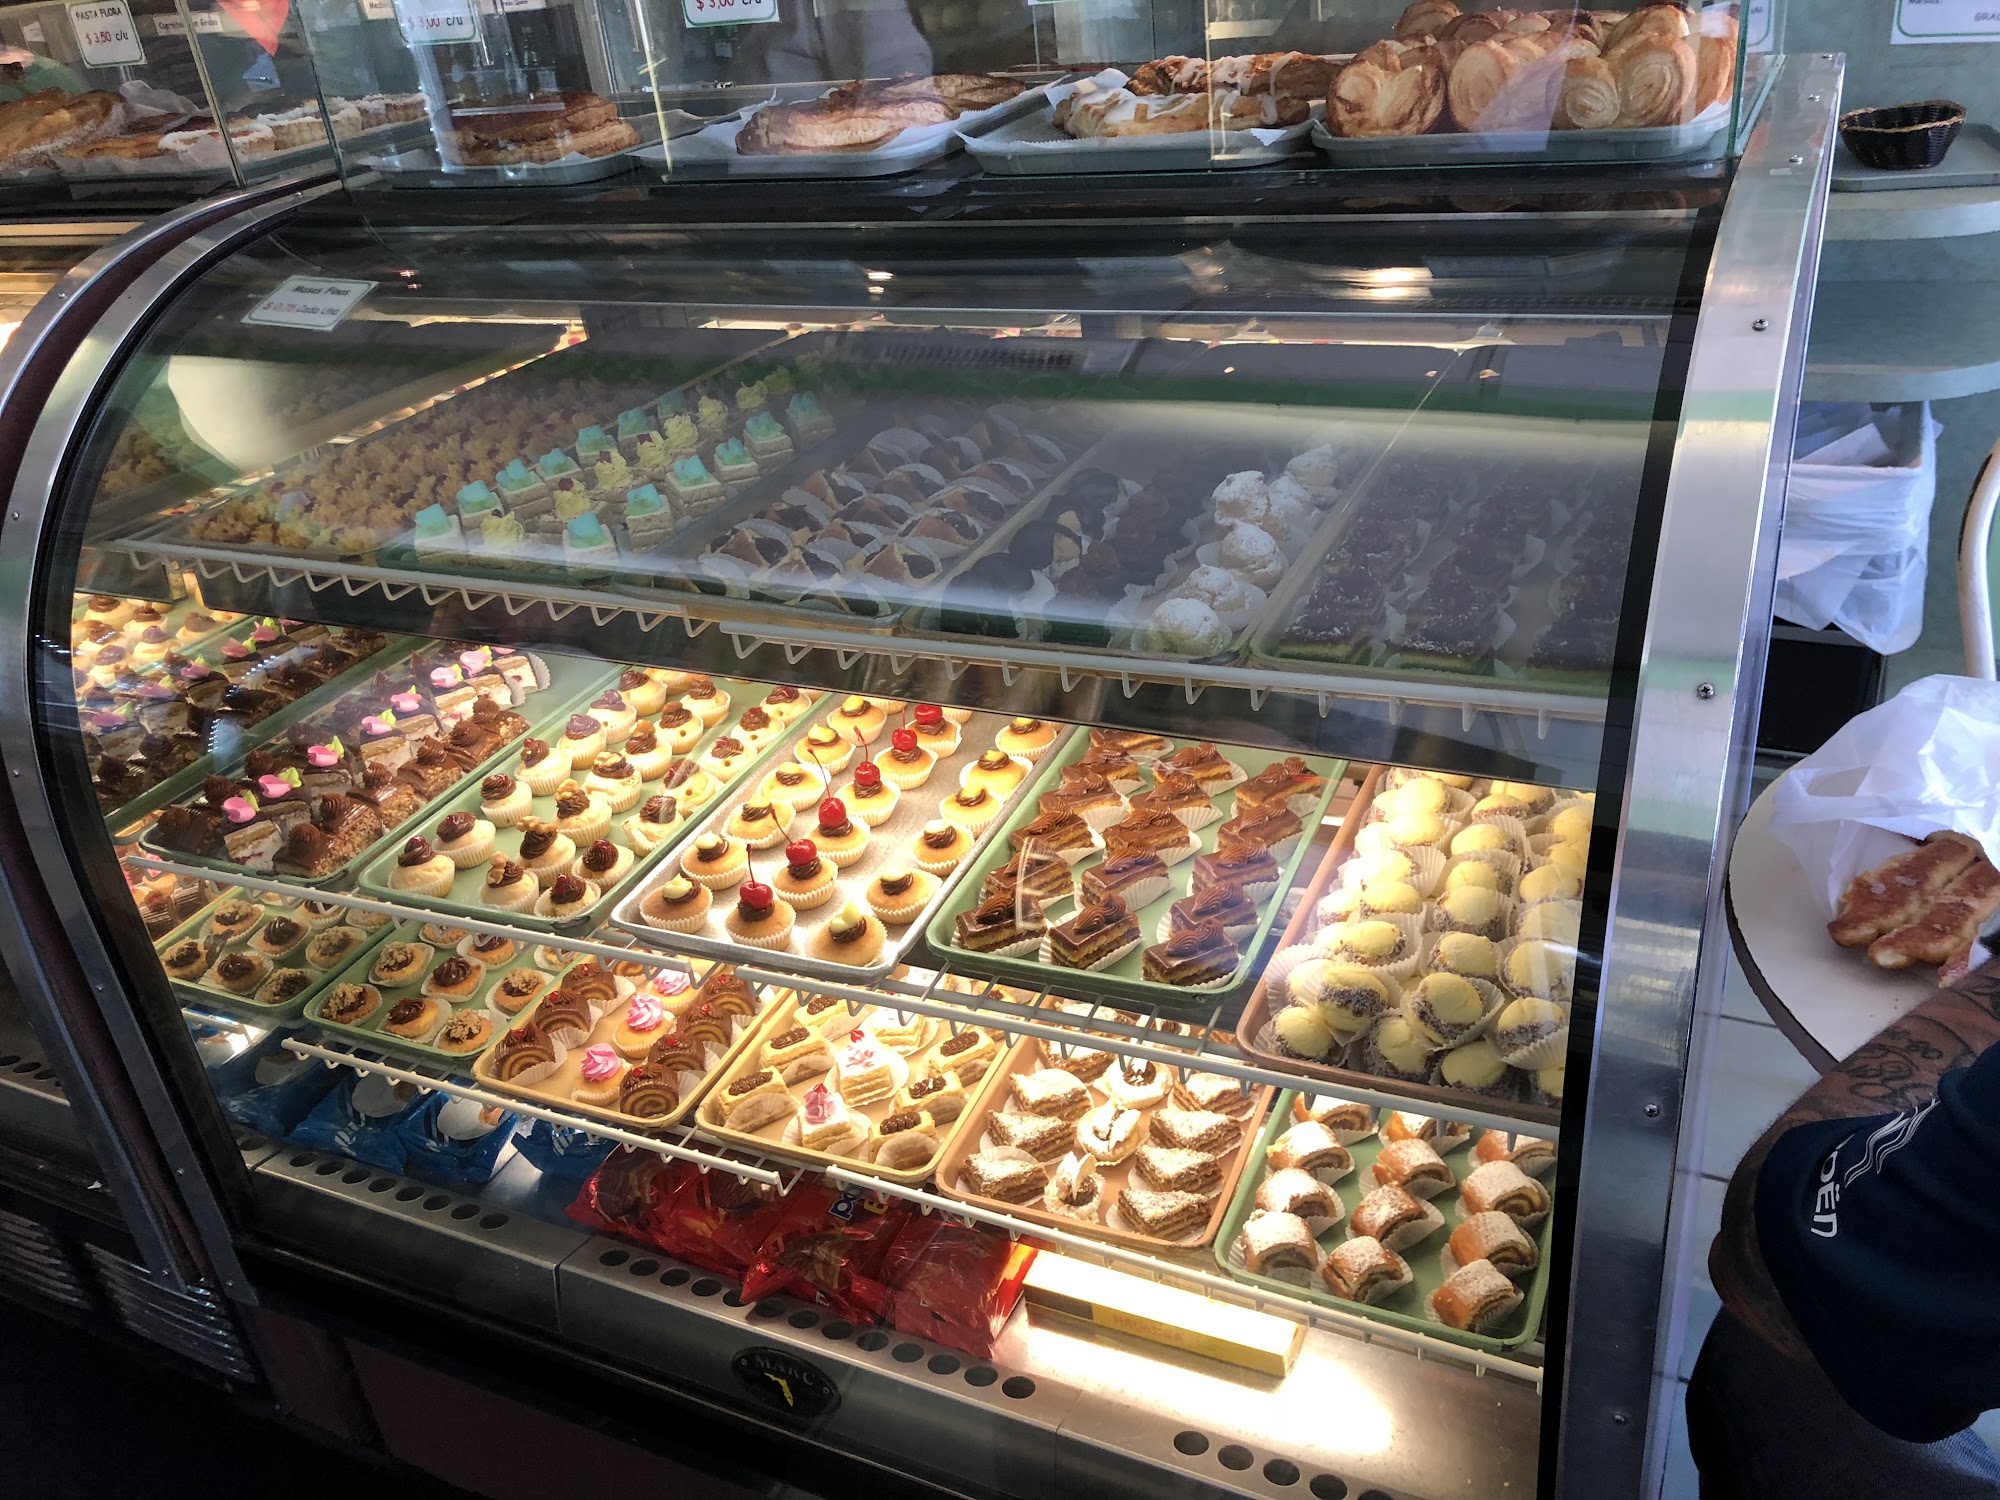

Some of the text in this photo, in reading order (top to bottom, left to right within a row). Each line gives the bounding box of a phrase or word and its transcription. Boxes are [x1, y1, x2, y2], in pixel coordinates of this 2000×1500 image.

[75, 7, 123, 21] PASTA FLORA
[446, 13, 464, 26] c/u
[85, 32, 93, 46] $
[115, 29, 129, 41] c/u
[292, 285, 351, 296] Masas Finas
[297, 304, 320, 314] Cada
